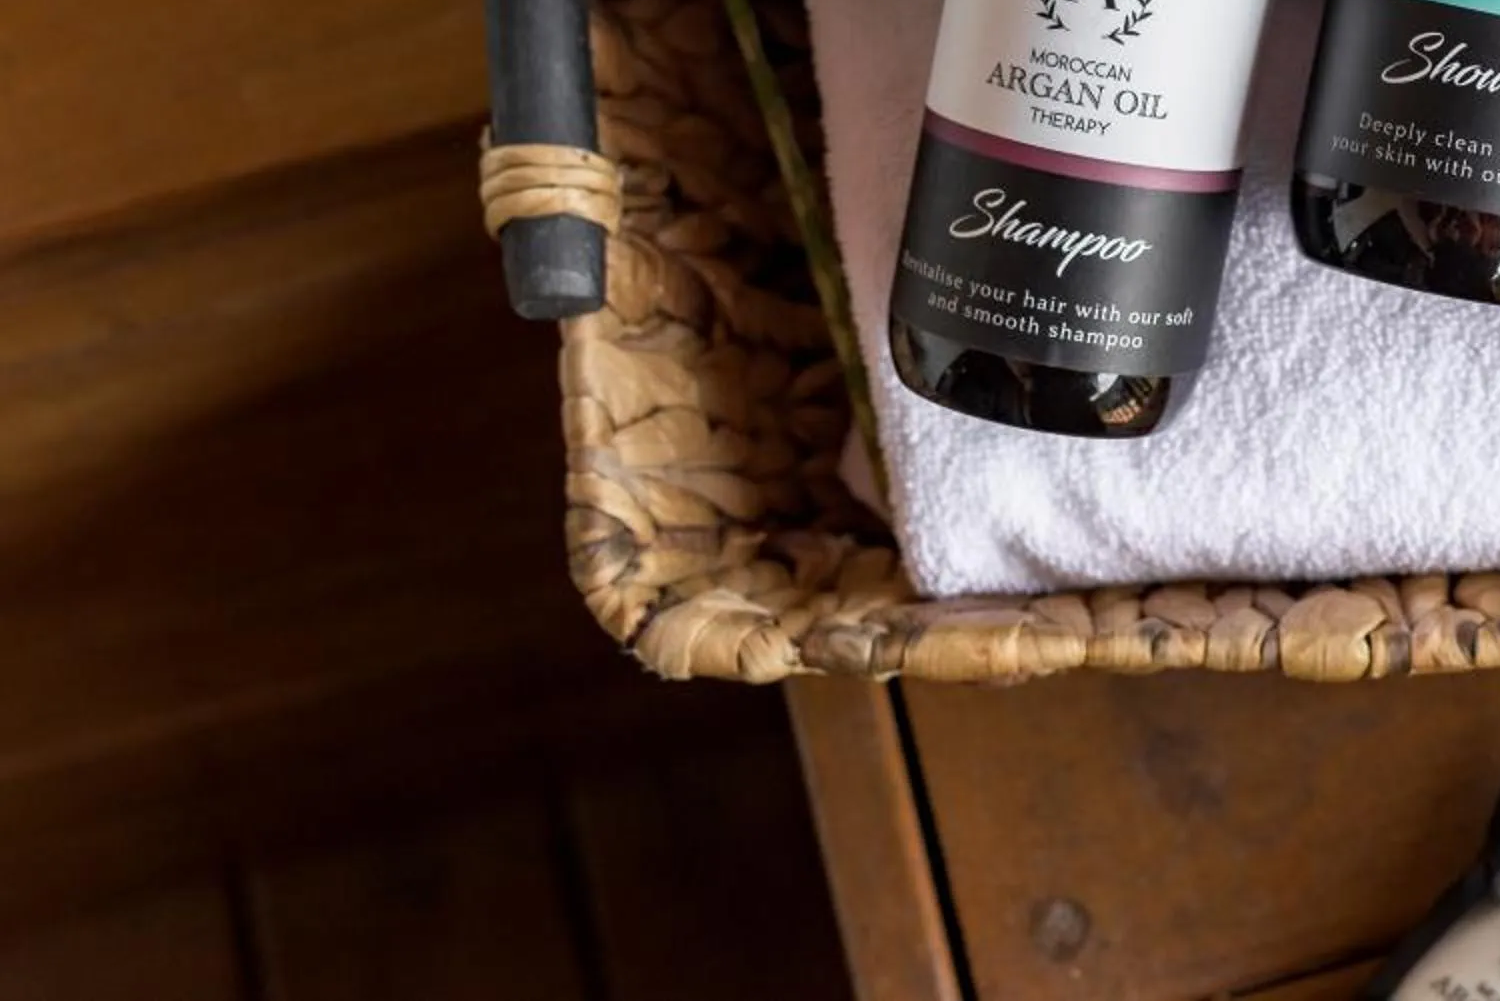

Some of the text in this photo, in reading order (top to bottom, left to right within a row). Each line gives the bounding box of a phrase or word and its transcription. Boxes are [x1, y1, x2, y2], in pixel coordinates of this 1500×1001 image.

[985, 62, 1169, 121] ARGAN OIL
[1030, 48, 1133, 84] MOROCCAN
[1030, 106, 1111, 137] THERAPY
[1358, 111, 1428, 145] Deeply
[1433, 130, 1494, 158] clean
[1329, 132, 1369, 157] your
[1374, 140, 1417, 168] skin
[1425, 153, 1475, 181] with
[948, 188, 1153, 278] Shampoo
[902, 249, 1195, 328] vitalise your hair with our soft
[928, 290, 1145, 352] and smooth shampoo
